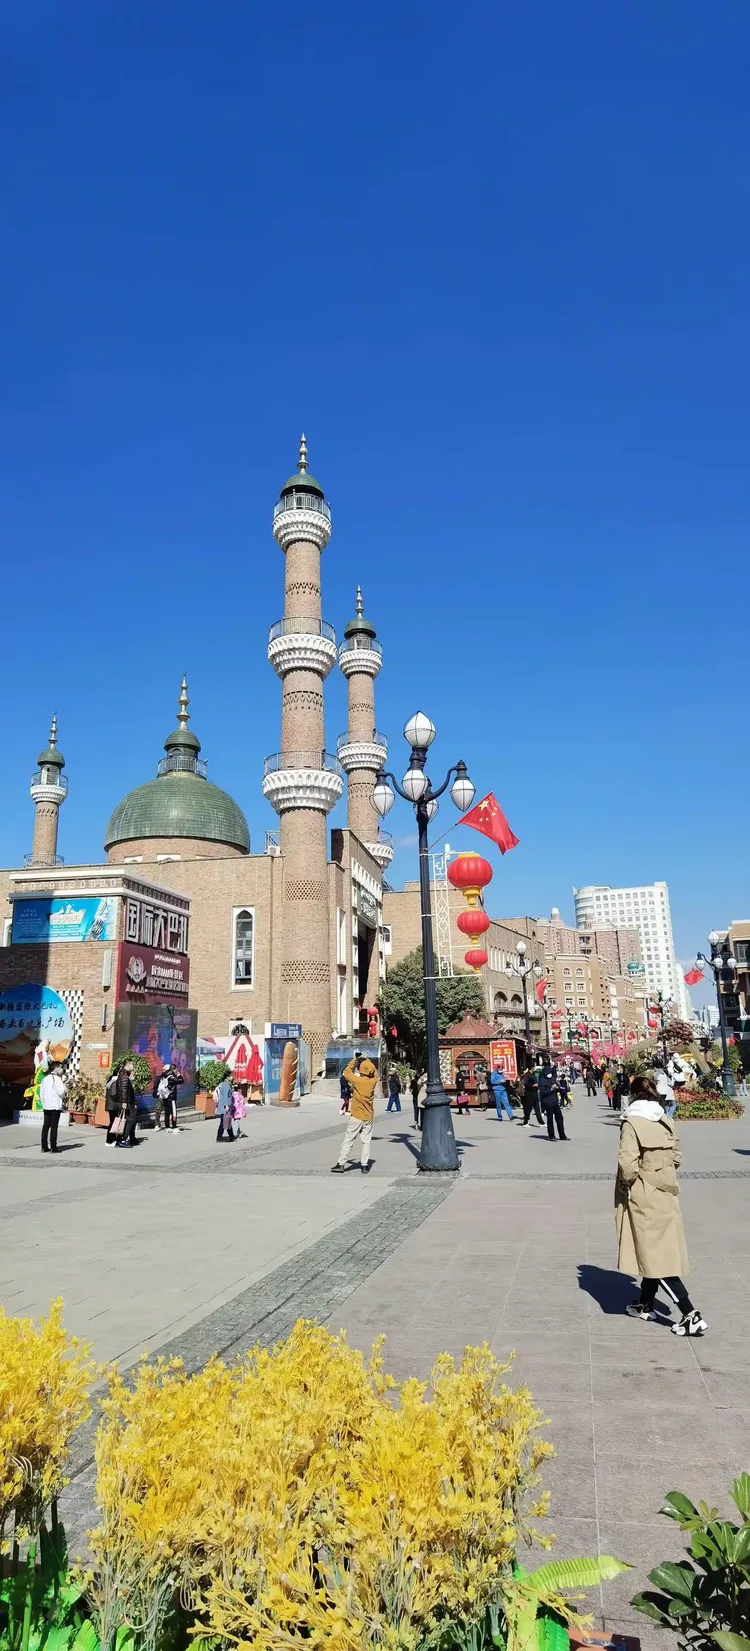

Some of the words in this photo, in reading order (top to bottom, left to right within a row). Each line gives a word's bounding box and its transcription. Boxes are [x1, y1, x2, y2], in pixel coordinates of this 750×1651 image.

[125, 898, 188, 955] 国际大巴扎
